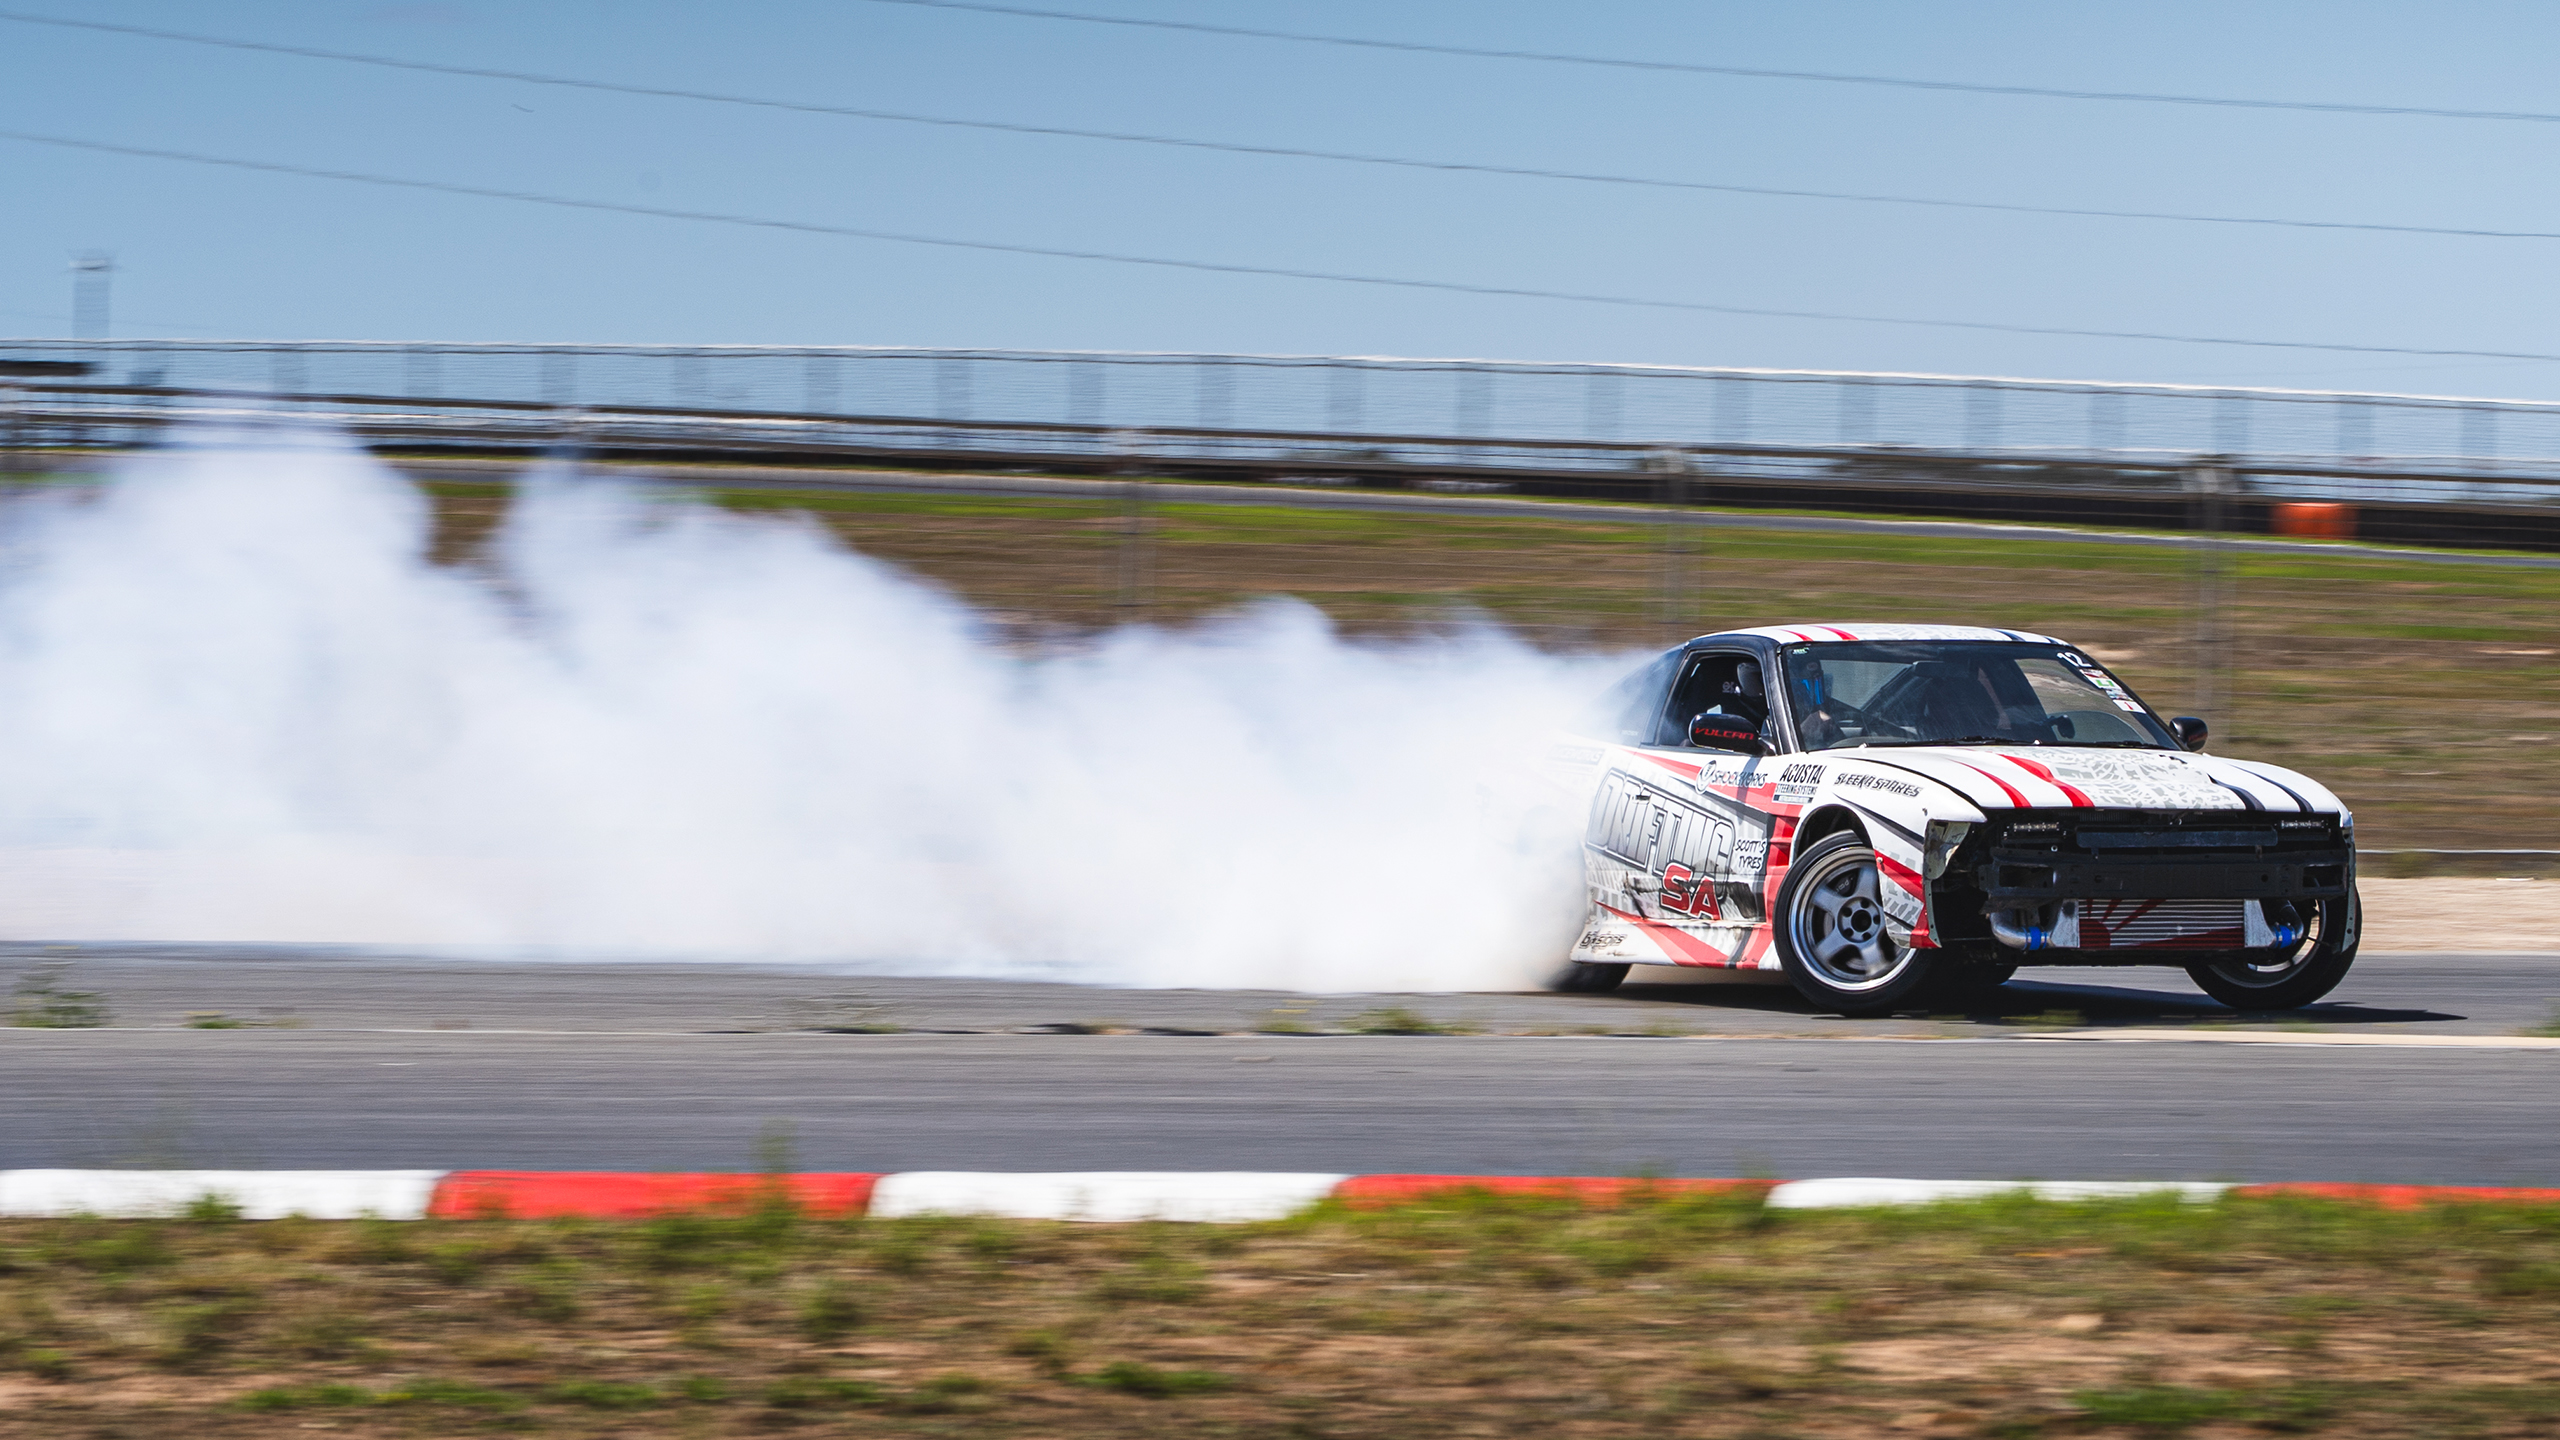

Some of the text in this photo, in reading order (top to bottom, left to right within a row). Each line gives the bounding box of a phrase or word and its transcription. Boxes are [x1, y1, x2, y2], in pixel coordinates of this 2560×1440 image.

[2057, 652, 2092, 667] 12
[1695, 727, 1754, 740] VULCAN
[1775, 783, 1818, 795] STEERING SYSTEMS
[1834, 773, 1922, 797] SLEEKA SPARES
[1586, 769, 1736, 899] DRIFTING
[1735, 839, 1766, 853] SCOTT'S
[1739, 855, 1762, 869] TYRES
[1660, 863, 1722, 921] SA
